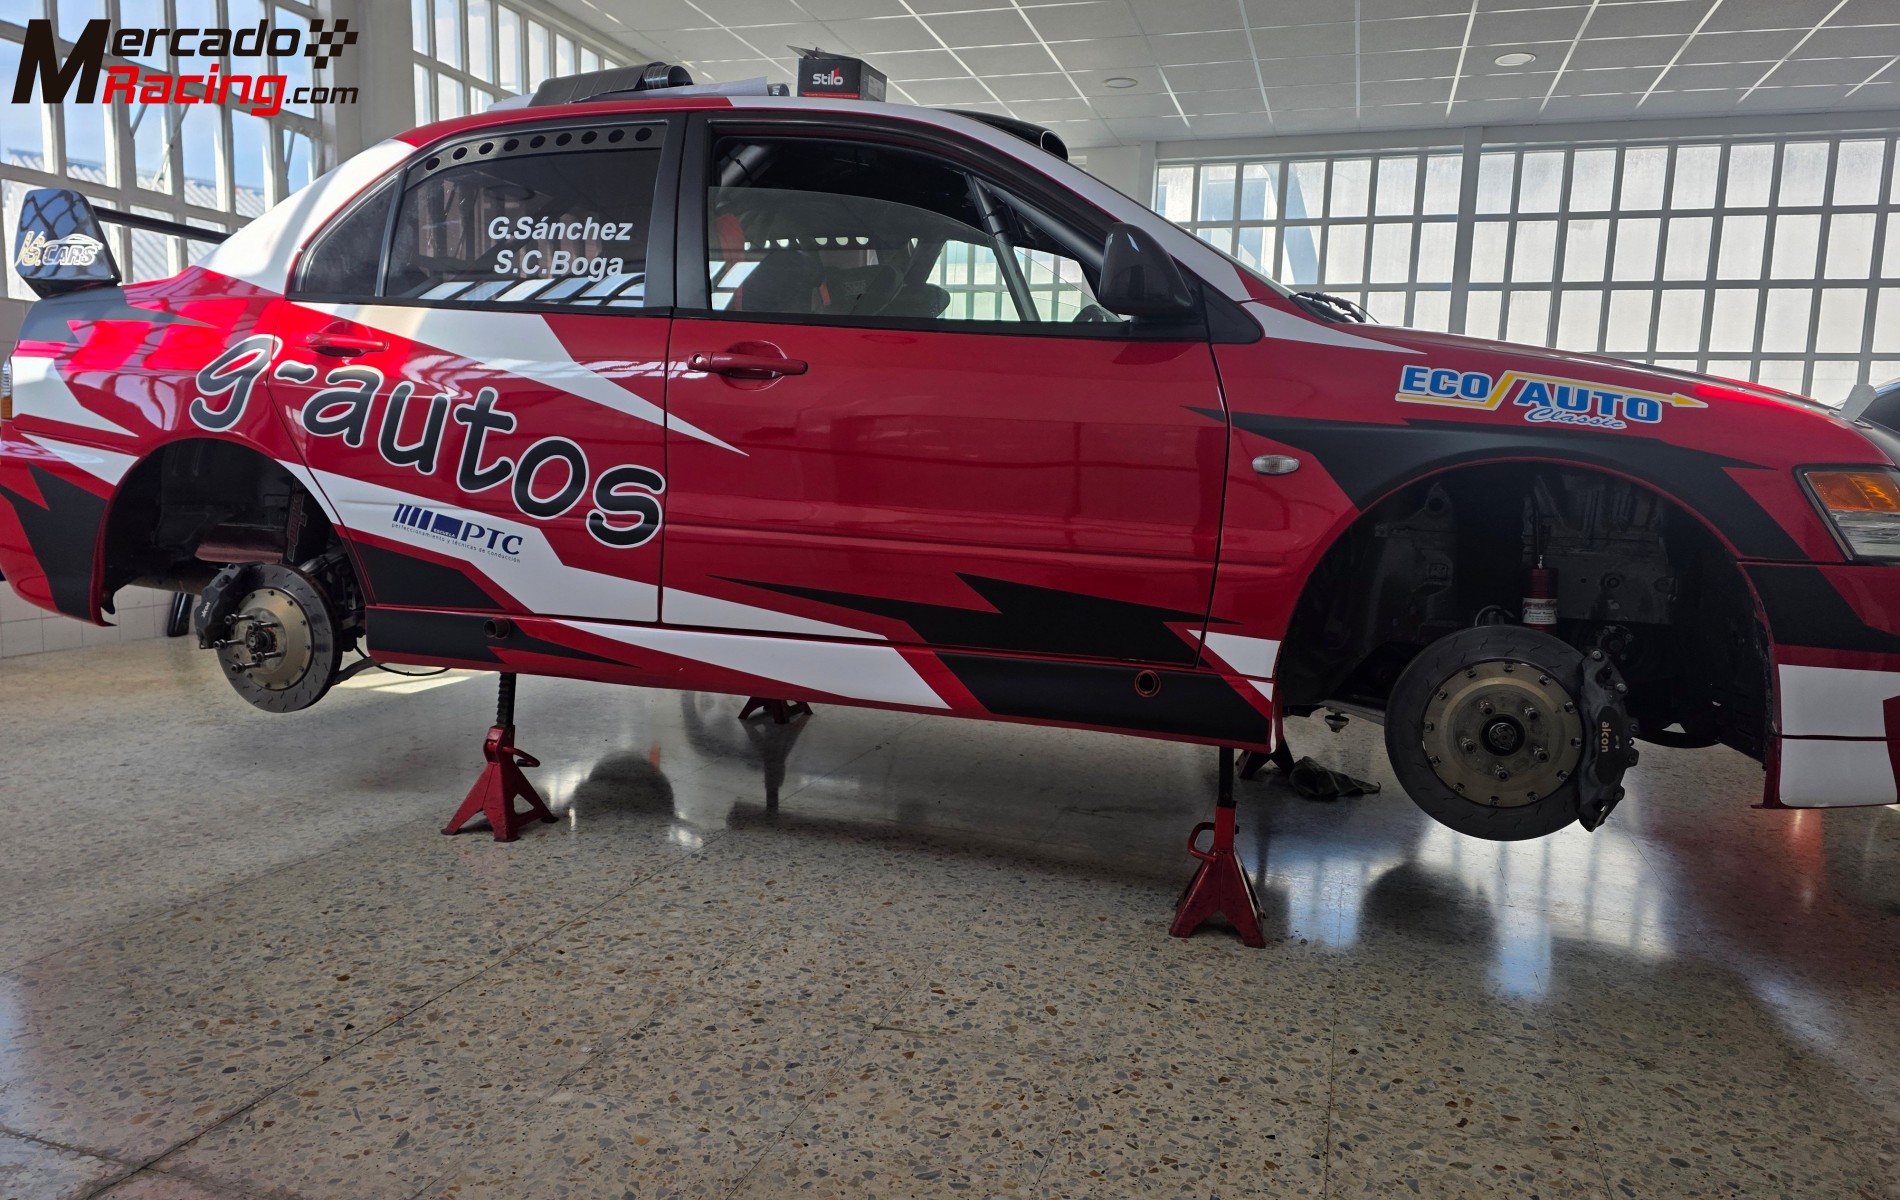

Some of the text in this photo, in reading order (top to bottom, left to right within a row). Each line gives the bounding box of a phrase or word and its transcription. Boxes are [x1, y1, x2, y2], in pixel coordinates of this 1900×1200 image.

[812, 68, 844, 86] Stilo
[1402, 366, 1662, 423] ECO AUTO
[1526, 407, 1628, 430] Classic
[189, 333, 667, 549] g-autos
[460, 521, 524, 556] PTC
[1601, 720, 1612, 754] alcon
